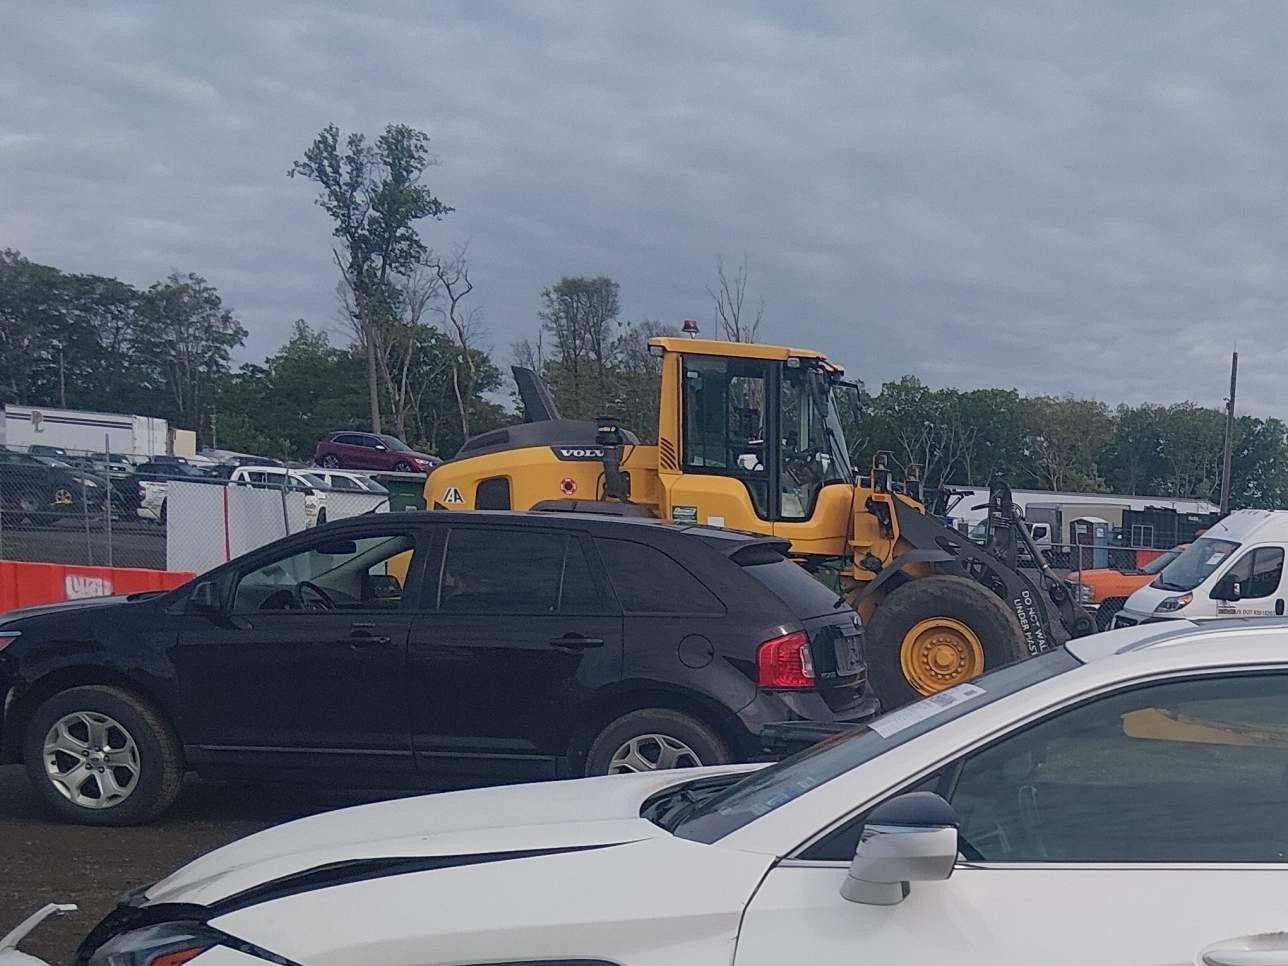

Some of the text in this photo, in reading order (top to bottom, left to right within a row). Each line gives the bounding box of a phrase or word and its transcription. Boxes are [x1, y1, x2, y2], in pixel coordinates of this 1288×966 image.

[560, 449, 604, 457] VOLV
[1014, 598, 1039, 656] UNDER MAST
[1021, 590, 1033, 606] DO
[1035, 629, 1048, 652] WAL
